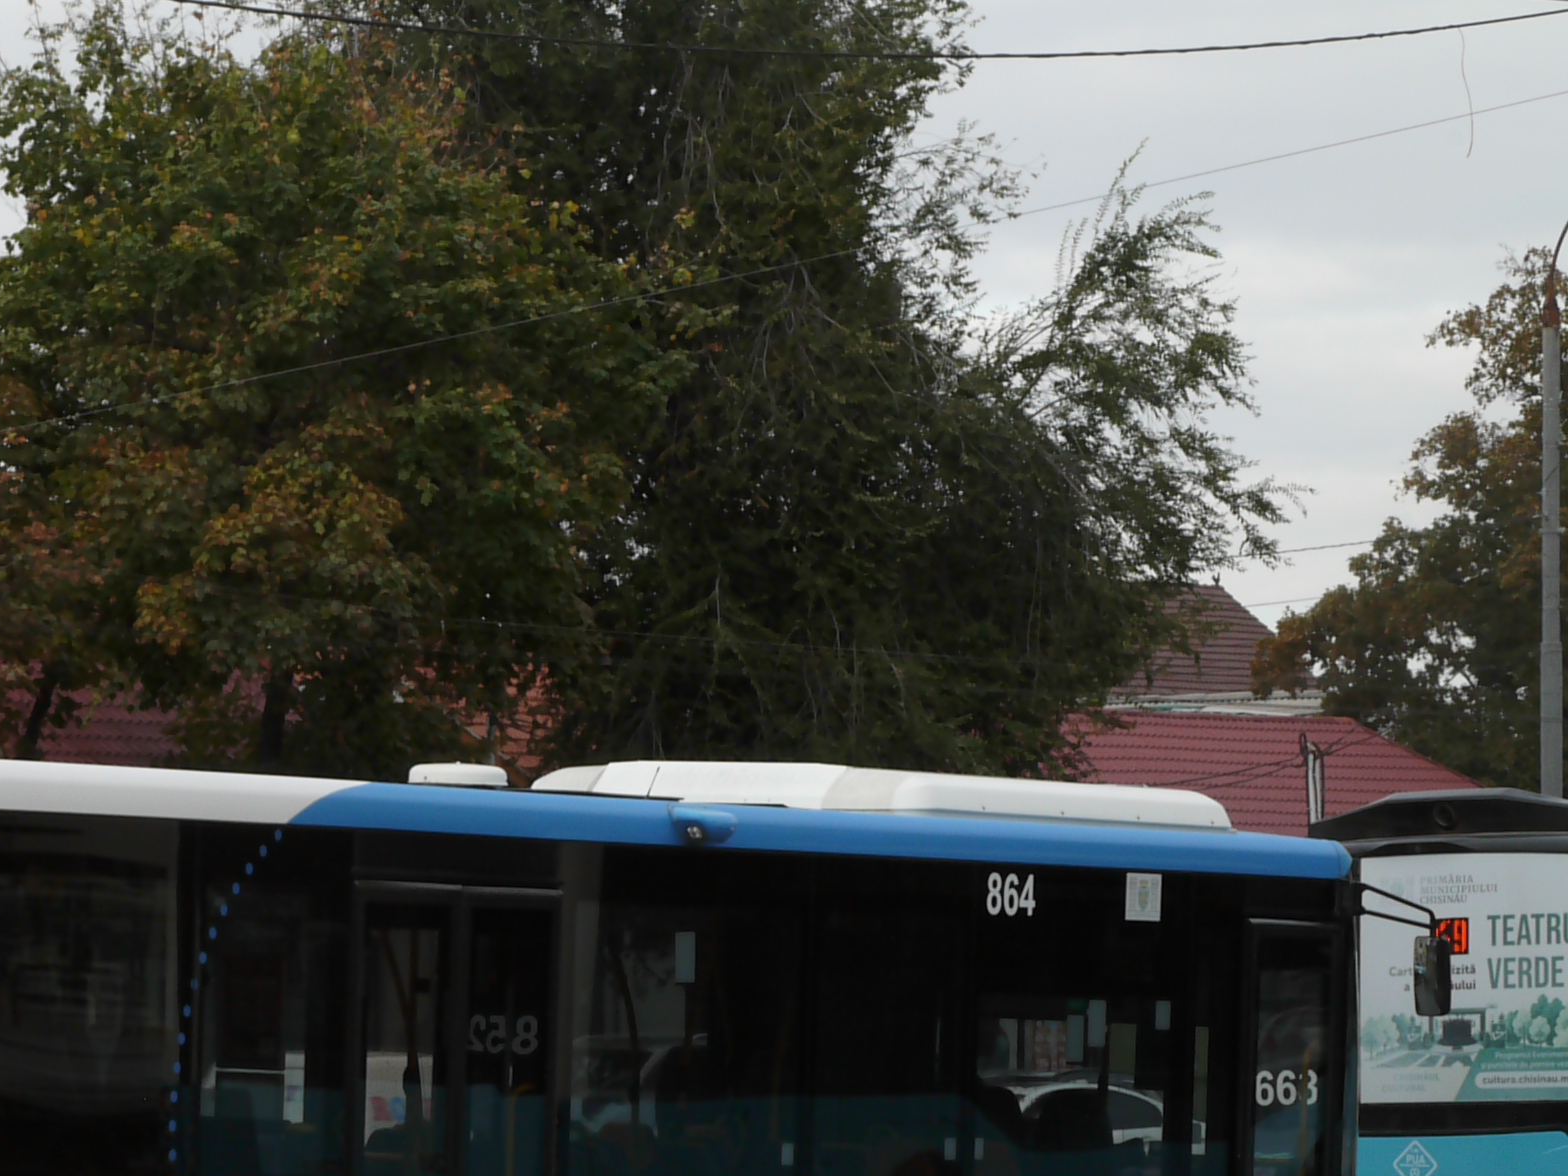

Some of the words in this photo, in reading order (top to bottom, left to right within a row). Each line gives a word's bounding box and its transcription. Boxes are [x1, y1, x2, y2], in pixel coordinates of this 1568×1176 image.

[986, 871, 1037, 917] 864
[1419, 883, 1498, 895] MUNICIPIULUI
[1388, 965, 1413, 978] Cart
[1450, 963, 1476, 976] izită
[1487, 955, 1565, 990] VERDE
[1405, 1153, 1426, 1166] PUA
